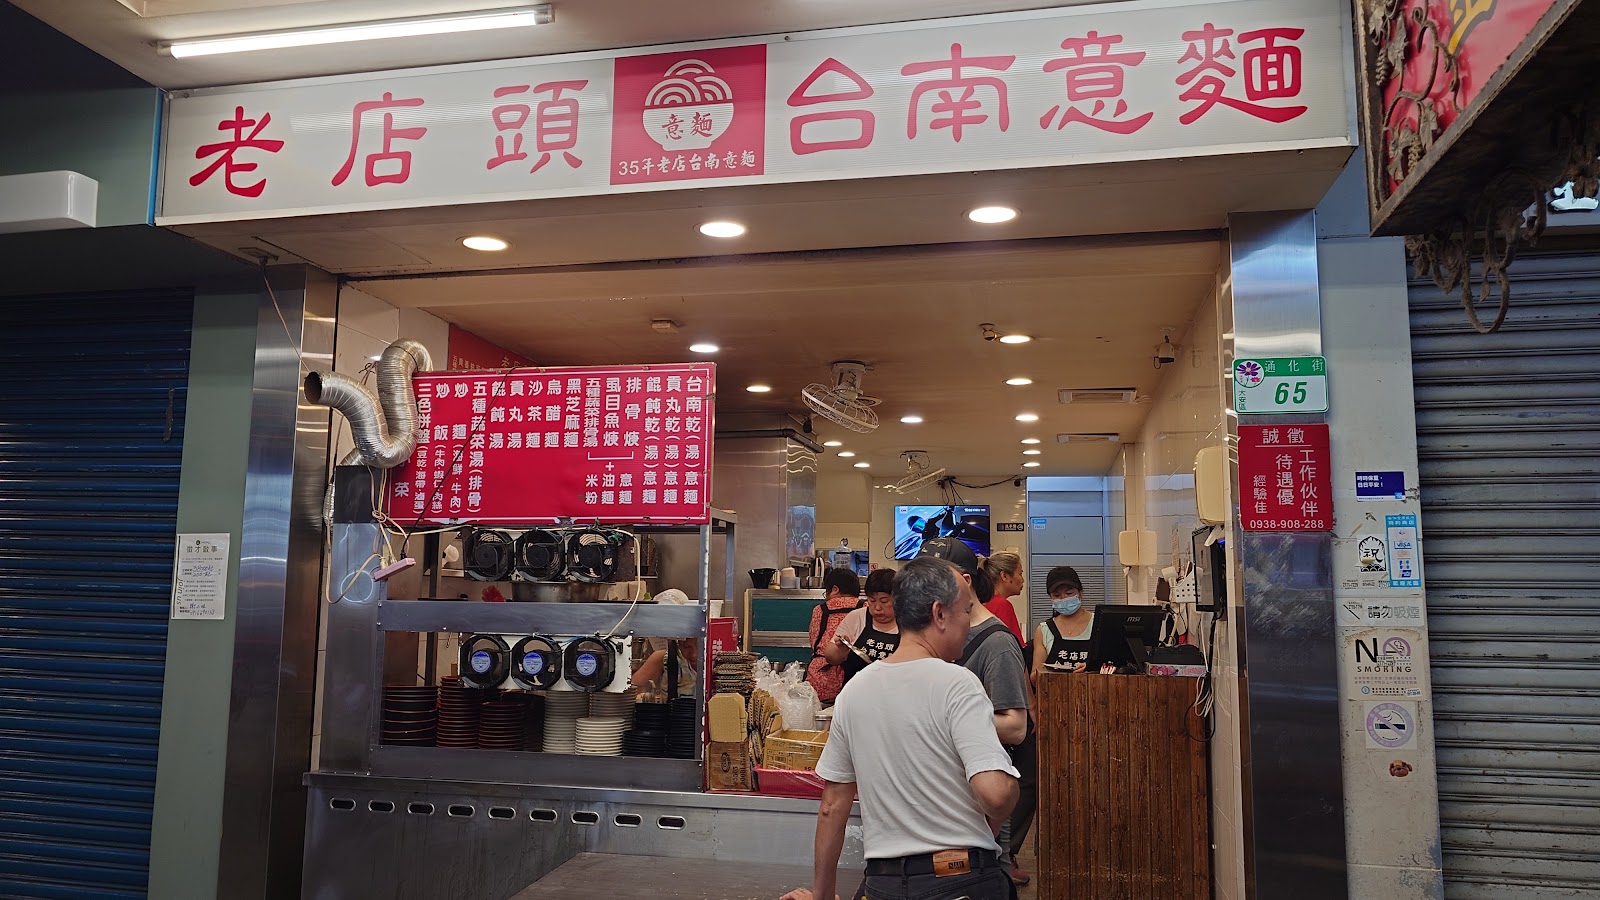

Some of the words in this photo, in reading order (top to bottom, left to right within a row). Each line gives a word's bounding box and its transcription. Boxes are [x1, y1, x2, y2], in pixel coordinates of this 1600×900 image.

[189, 79, 589, 198] 老店頭
[786, 22, 1308, 155] 台南意麵
[661, 111, 713, 140] 意麵
[618, 149, 756, 176] 35年老店台南意麵
[1264, 359, 1323, 373] 通化街
[1238, 390, 1247, 411] 大安區
[1274, 381, 1308, 405] 65
[488, 381, 506, 449] 餛飩湯
[507, 380, 525, 449] 貢丸湯
[525, 380, 543, 448] 沙茶麵
[544, 379, 562, 448] 烏醋麵
[564, 378, 582, 448] 黑芝麻麵
[1262, 428, 1305, 444] 誠徵
[584, 473, 598, 504] 米粉
[601, 473, 615, 504] 油麵
[618, 473, 633, 504] 意麵
[1253, 475, 1267, 514] 經驗佳
[1275, 453, 1295, 506] 待遇優
[1298, 449, 1319, 518] 工作伙伴
[1249, 519, 1325, 529] 0938-908-288
[1367, 605, 1421, 619] 請勿吸煙
[1357, 665, 1412, 673] SMOKING
